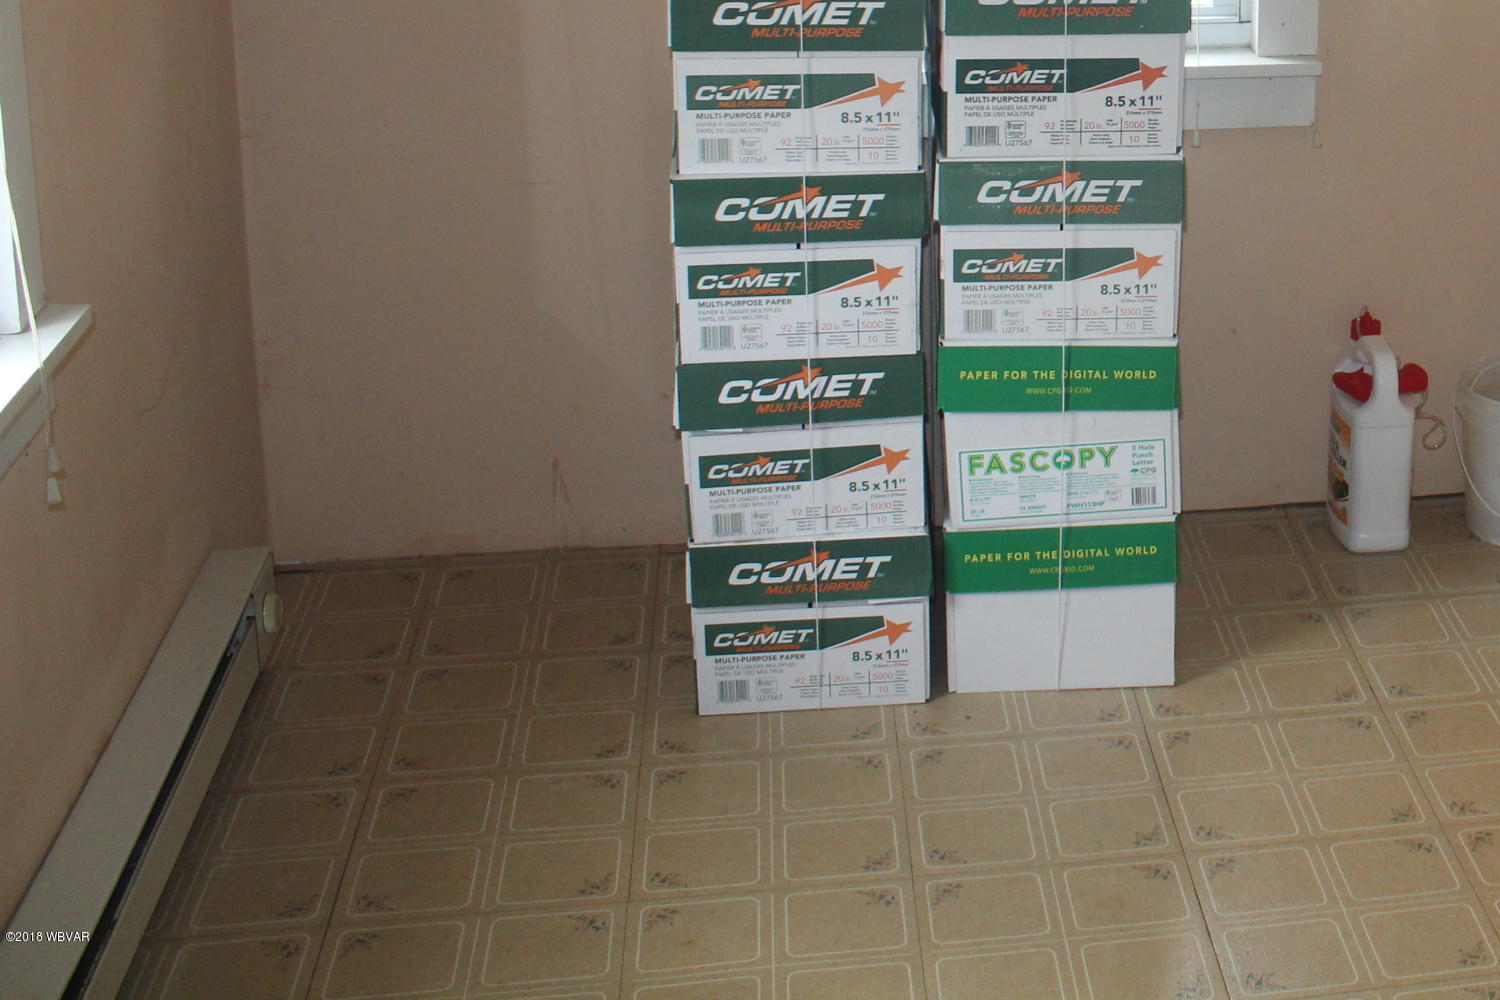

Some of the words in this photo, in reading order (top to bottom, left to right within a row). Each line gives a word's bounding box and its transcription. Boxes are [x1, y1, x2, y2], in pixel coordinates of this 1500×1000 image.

[712, 2, 886, 26] COMET
[1017, 6, 1136, 18] MULTI-PURPOSE
[751, 27, 864, 38] MULTI-PURPOSE
[964, 70, 1067, 85] COMET
[695, 85, 801, 101] COMET
[1105, 96, 1126, 107] 8.5
[1128, 99, 1137, 107] x
[696, 112, 762, 120] MULTI-PURPOSE
[841, 112, 862, 123] 8.5
[866, 115, 874, 123] x
[1044, 122, 1056, 130] 92
[1084, 121, 1095, 129] 20
[1124, 120, 1145, 129] 5000
[862, 136, 885, 145] 5000
[1129, 135, 1139, 143] 10
[976, 179, 1143, 204] COMET
[714, 194, 886, 222] COMET
[1013, 204, 1122, 216] MULTI-PURPOSE
[752, 219, 864, 233] MULTI-PURPOSE
[961, 259, 1064, 273] COMET
[696, 272, 801, 290] COMET
[1100, 284, 1121, 295] 8.5
[1123, 287, 1132, 295] x
[698, 299, 762, 308] MULTI-PURPOSE
[840, 297, 862, 308] 8.5
[865, 299, 873, 307] x
[861, 320, 883, 329] 5000
[959, 370, 998, 380] PAPER
[1003, 370, 1028, 380] FOR
[1033, 370, 1056, 380] THE
[1063, 369, 1109, 380] DIGITAL
[1114, 369, 1157, 380] WORLD
[717, 372, 886, 405] COMET
[755, 398, 865, 415] MULTI-PURPOSE
[967, 445, 1119, 476] FASCOPY
[707, 458, 810, 479] COMET
[709, 486, 773, 496] MULTI-PURPOSE
[775, 484, 801, 492] PAPER
[849, 481, 869, 492] 8.5
[964, 554, 1002, 563] PAPER
[1007, 552, 1030, 561] FOR
[1035, 550, 1058, 560] THE
[1063, 548, 1110, 559] DIGITAL
[1115, 545, 1158, 556] WORLD
[728, 555, 892, 586] COMET
[765, 580, 872, 595] MULTI-PURPOSE
[713, 628, 814, 647] COMET
[714, 655, 778, 664] MULTI-PURPOSE
[780, 653, 805, 661] PAPER
[852, 651, 873, 661] 8.5
